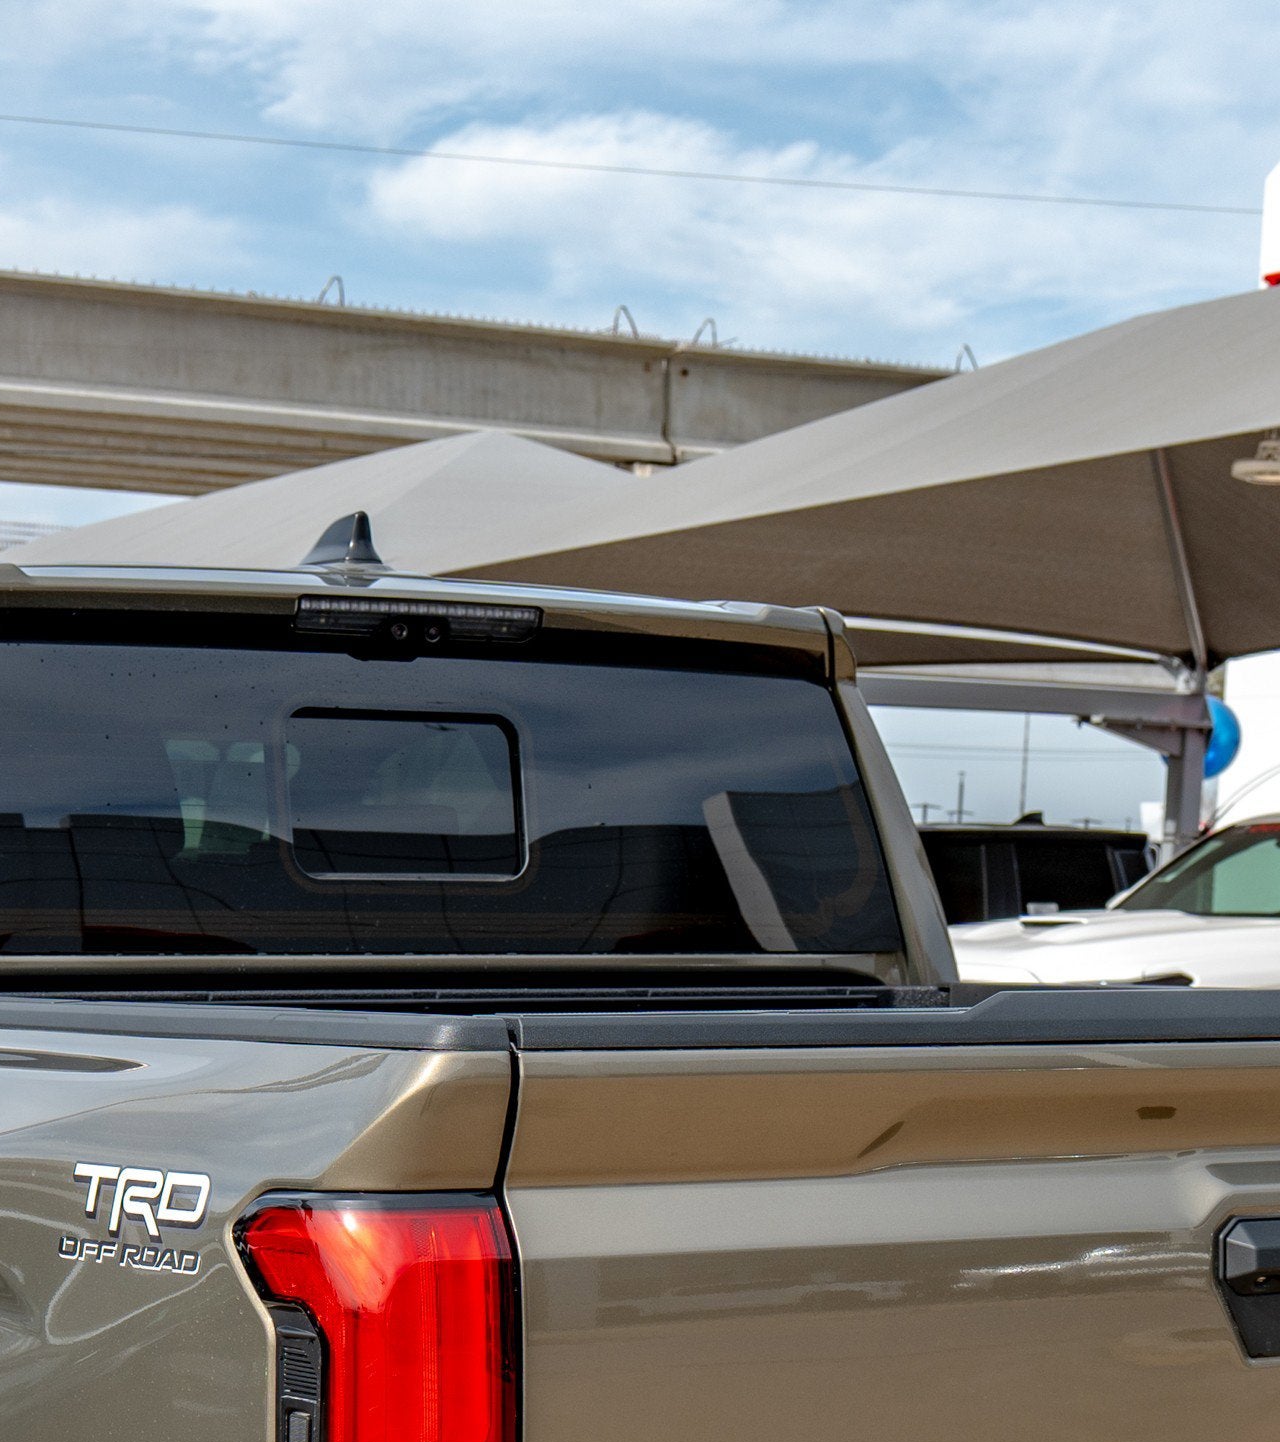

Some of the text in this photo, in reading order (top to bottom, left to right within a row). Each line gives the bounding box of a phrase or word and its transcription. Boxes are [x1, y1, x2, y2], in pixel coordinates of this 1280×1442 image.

[73, 1161, 211, 1243] TRD
[59, 1236, 201, 1275] OFF ROAD
